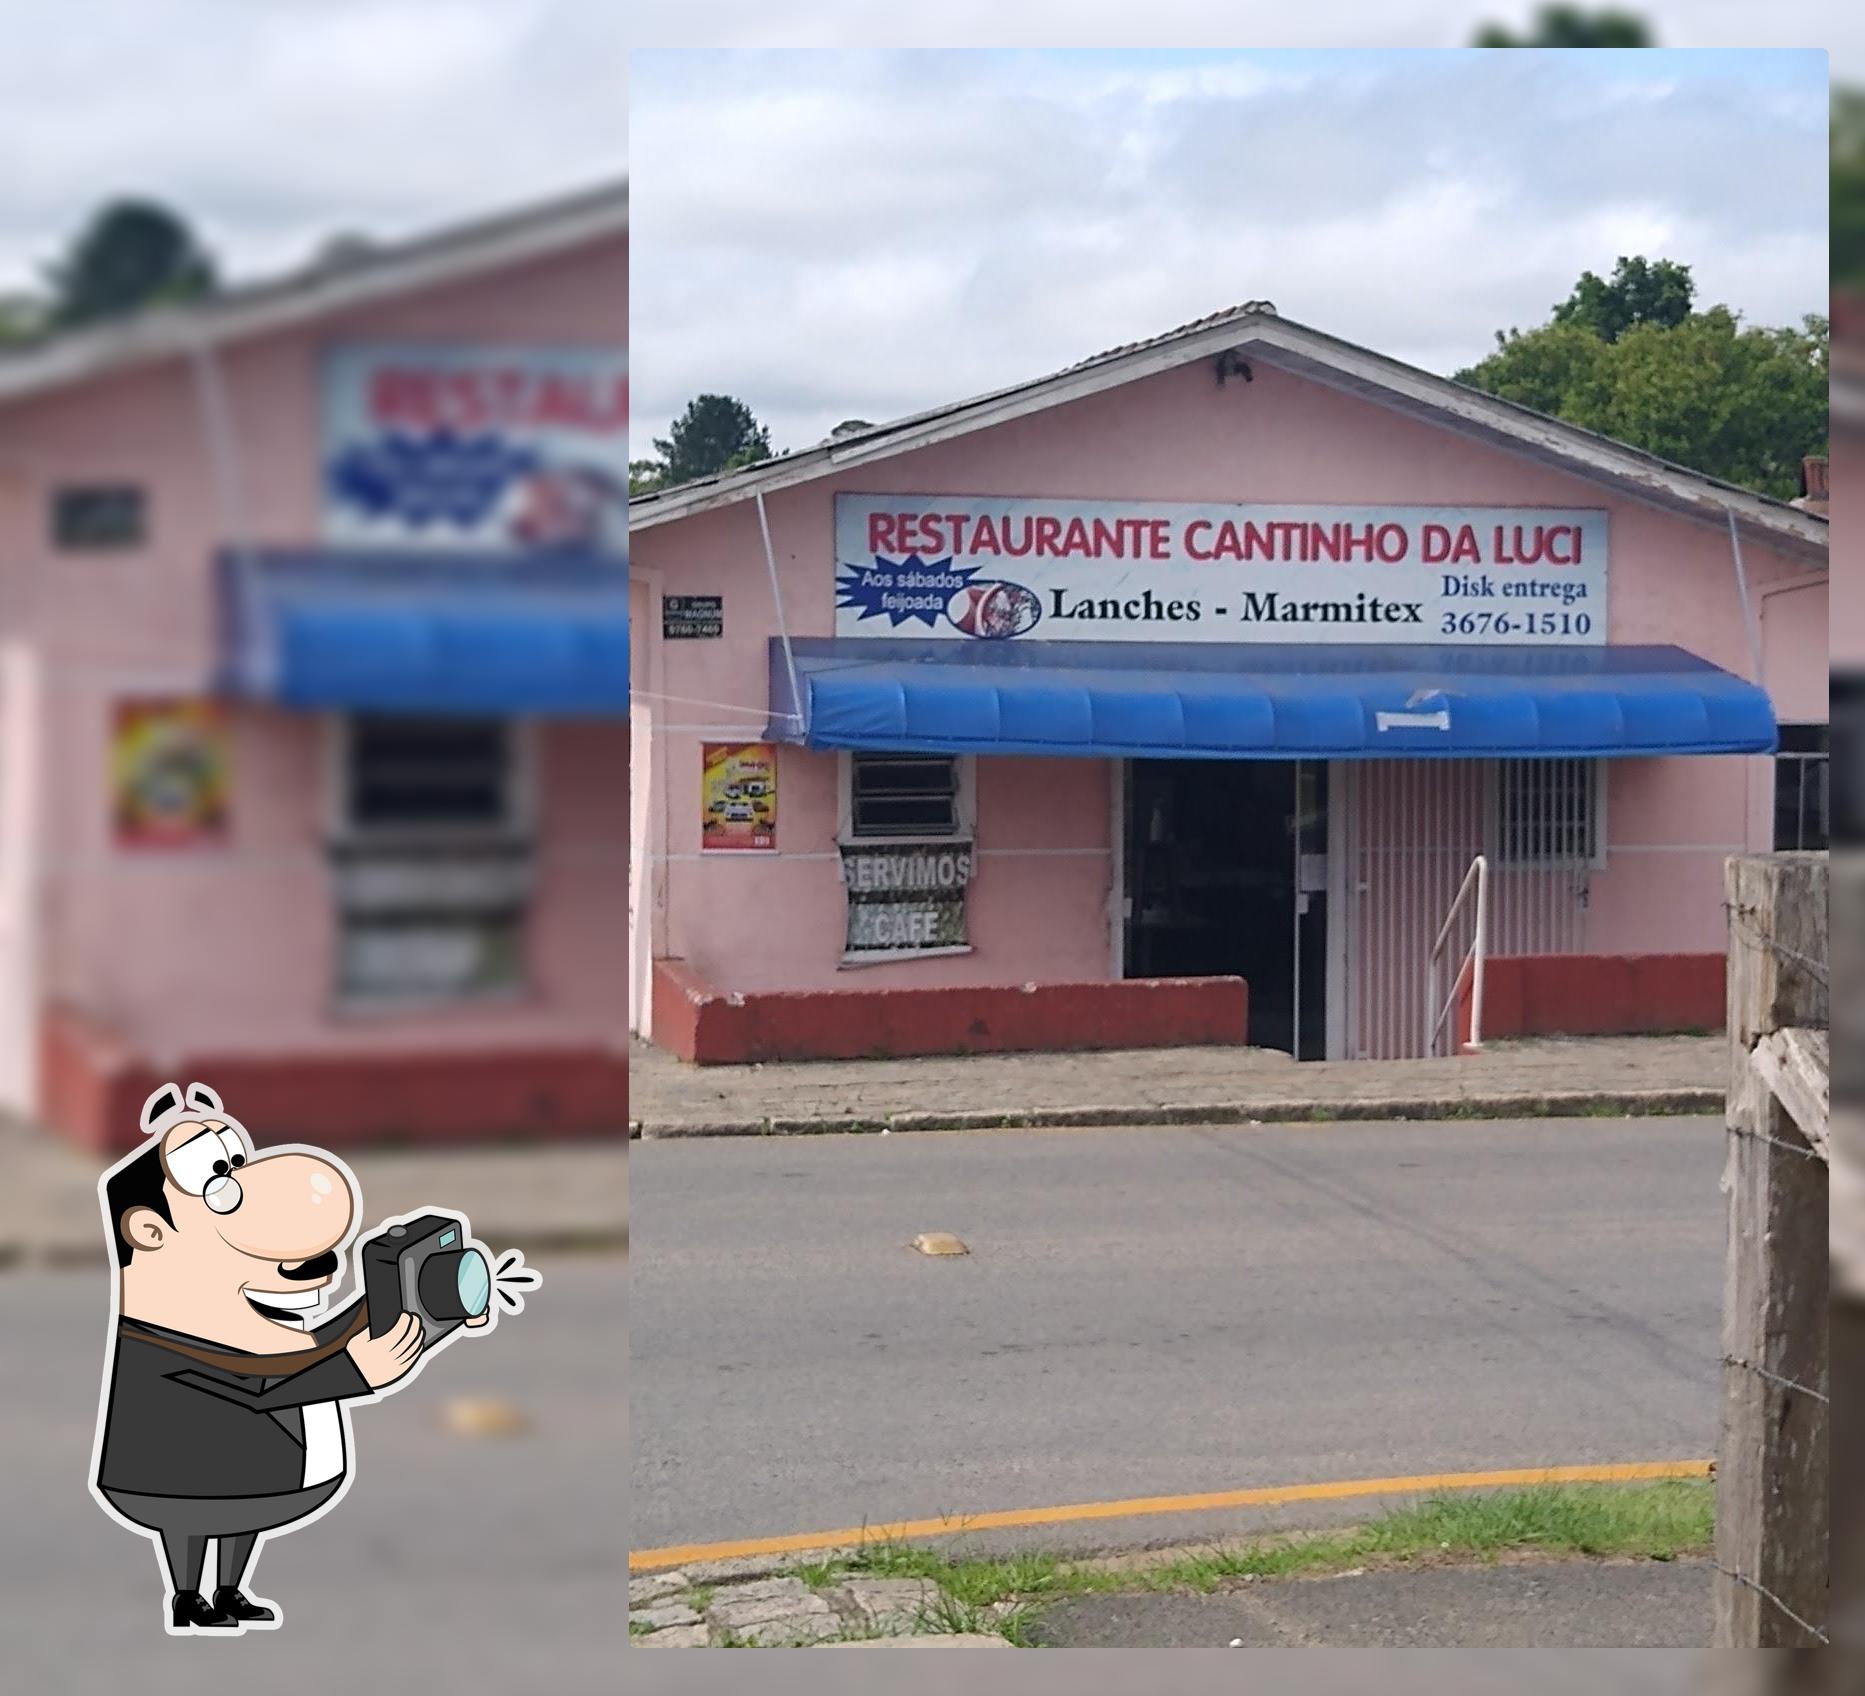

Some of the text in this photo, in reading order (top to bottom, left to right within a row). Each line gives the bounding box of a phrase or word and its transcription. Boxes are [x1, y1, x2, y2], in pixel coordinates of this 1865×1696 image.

[868, 512, 1583, 566] RESTAURANTE CANTINHO DA LUCI
[861, 571, 965, 589] Aos sábados
[1441, 574, 1588, 605] Disk entrega
[881, 593, 944, 613] feijoada
[1049, 588, 1201, 621] Lanches
[1240, 592, 1423, 624] Marmitex
[1441, 612, 1591, 635] 3676-1510
[844, 854, 970, 888] SERVIMOS
